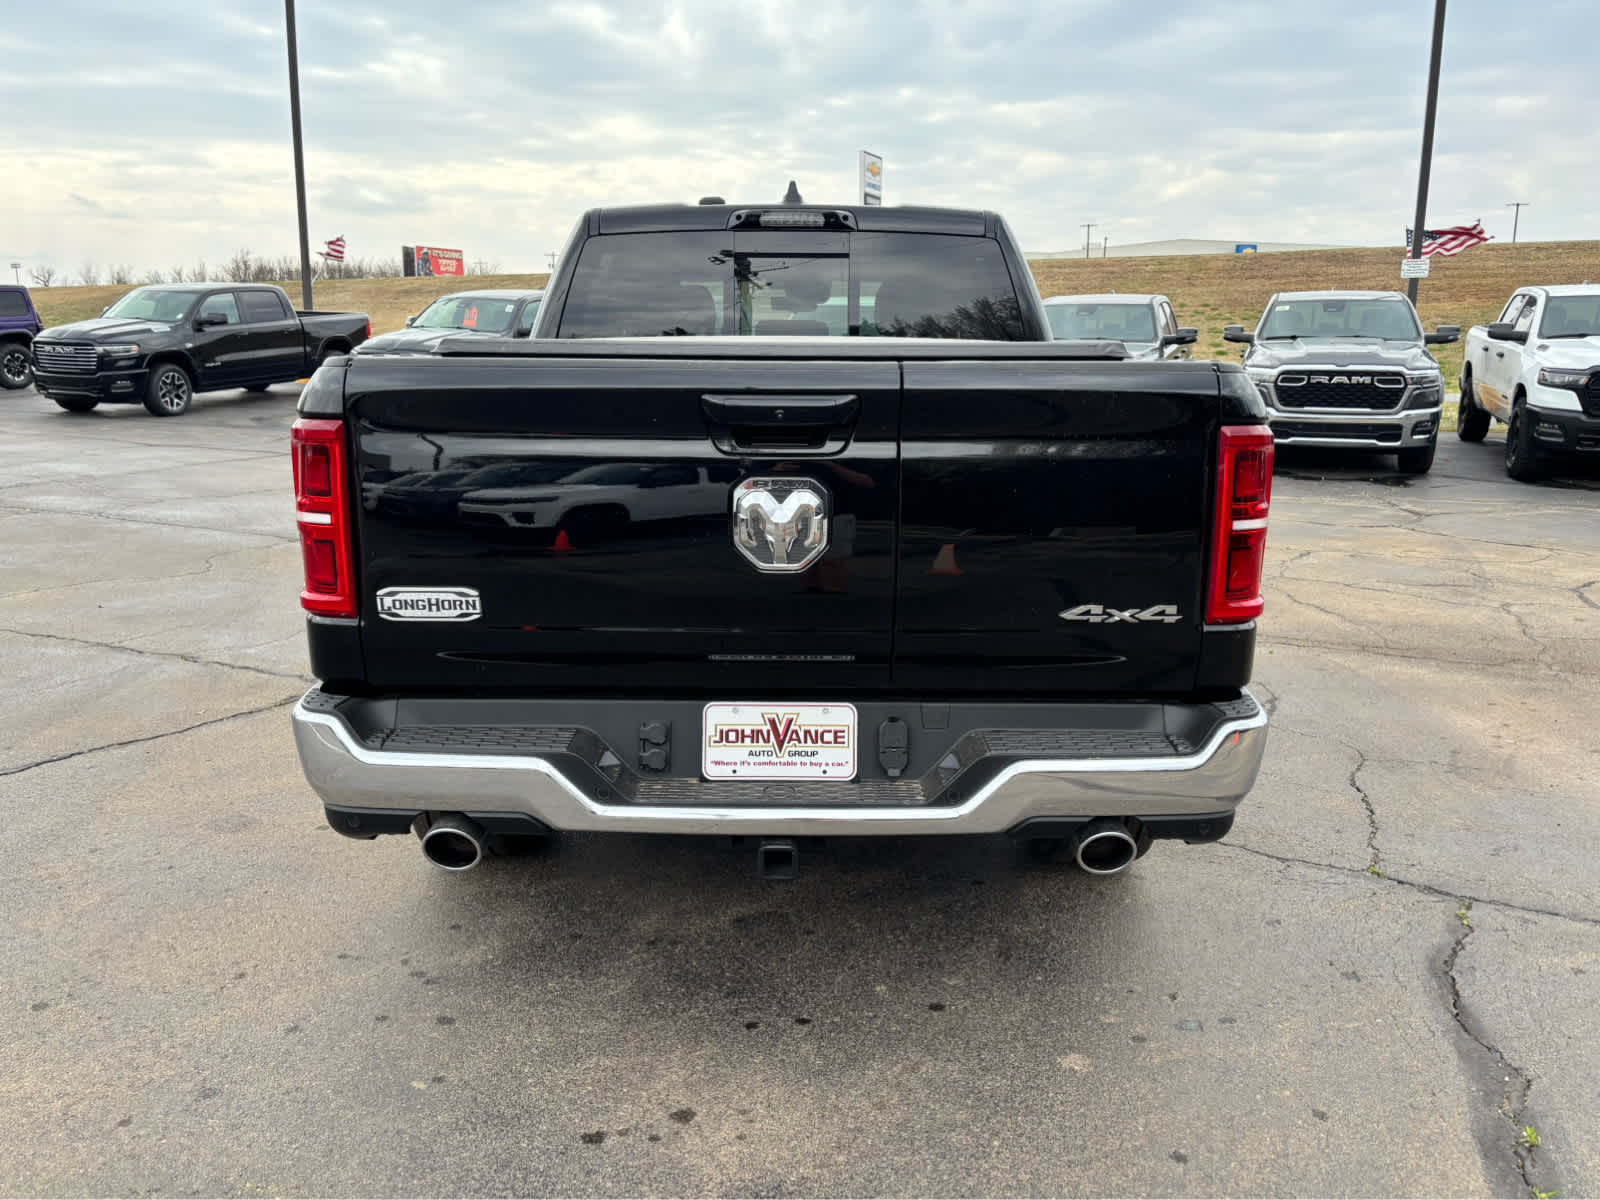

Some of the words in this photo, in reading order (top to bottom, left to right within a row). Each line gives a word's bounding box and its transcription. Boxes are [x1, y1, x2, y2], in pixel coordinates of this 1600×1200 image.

[1310, 376, 1371, 384] RAM
[379, 598, 477, 612] LONGHORN
[1058, 605, 1183, 623] 4x4
[713, 729, 770, 744] JOHN
[768, 718, 845, 751] VANCE
[809, 760, 822, 768] buy
